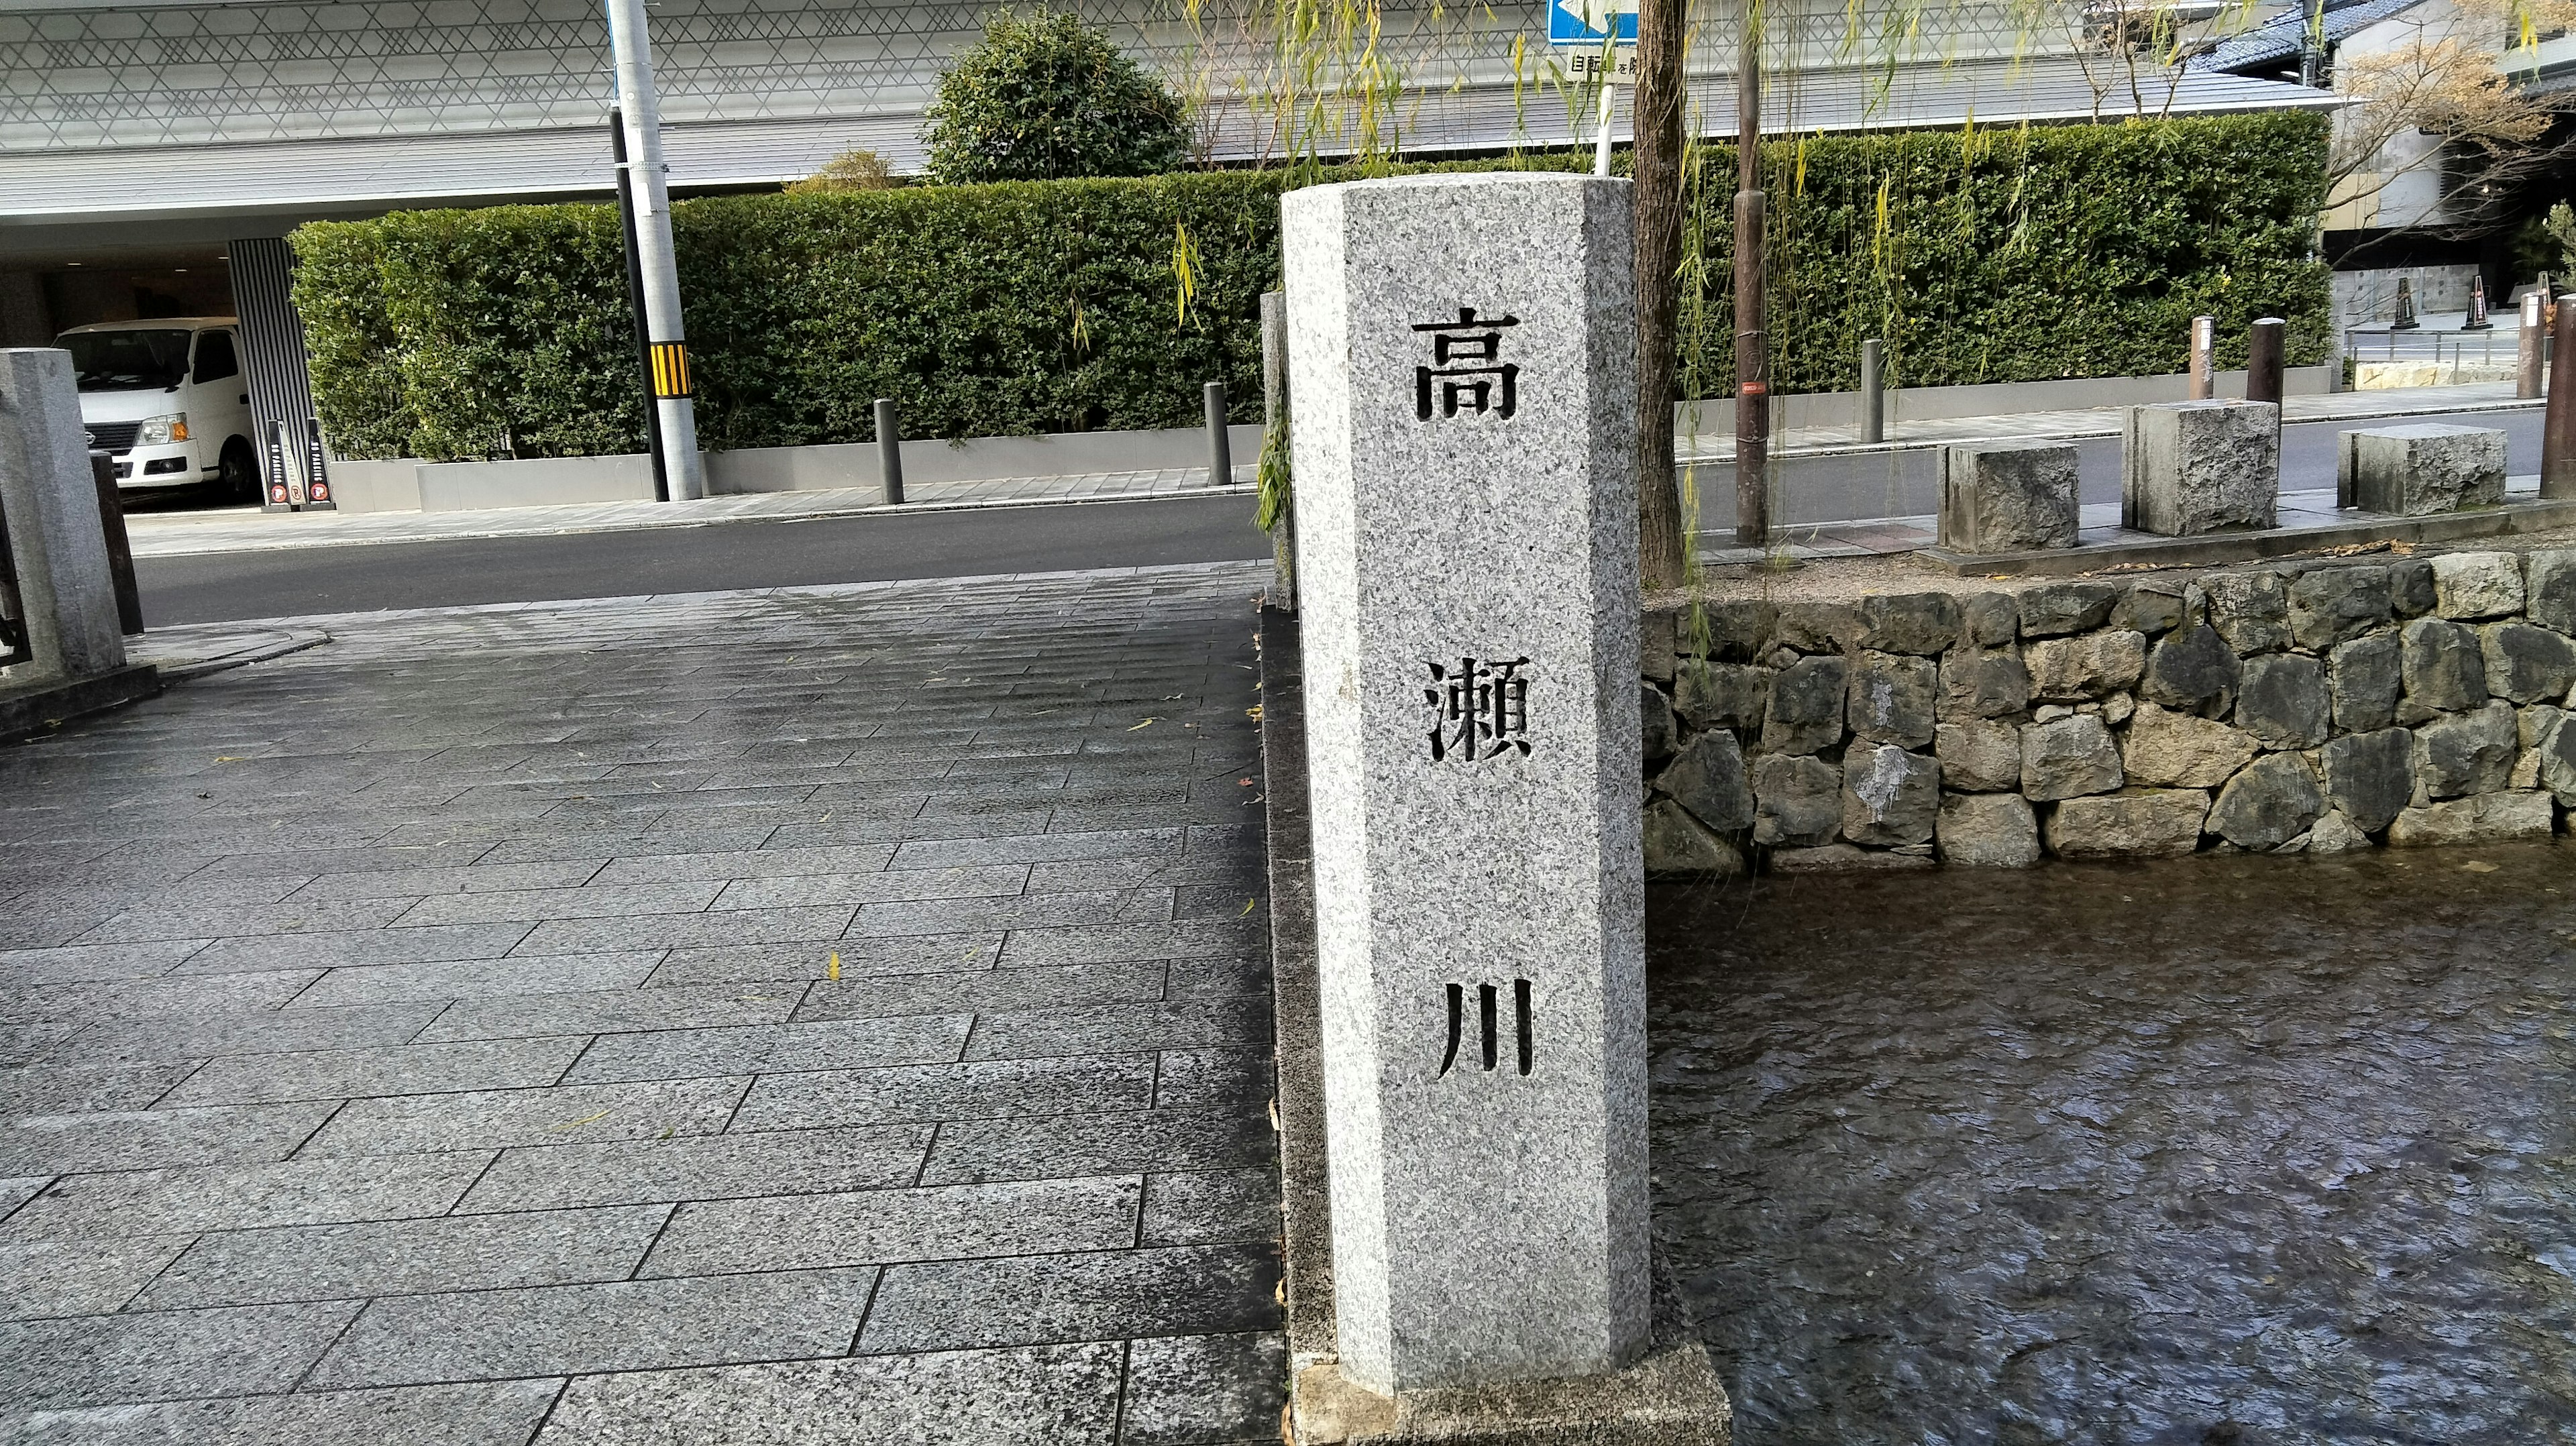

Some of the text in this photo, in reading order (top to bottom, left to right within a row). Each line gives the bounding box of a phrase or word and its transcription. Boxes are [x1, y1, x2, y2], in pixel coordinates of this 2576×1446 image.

[271, 444, 282, 483] NO PARKING
[311, 441, 323, 481] NO PARKING
[1411, 307, 1533, 1080] 高瀬川
